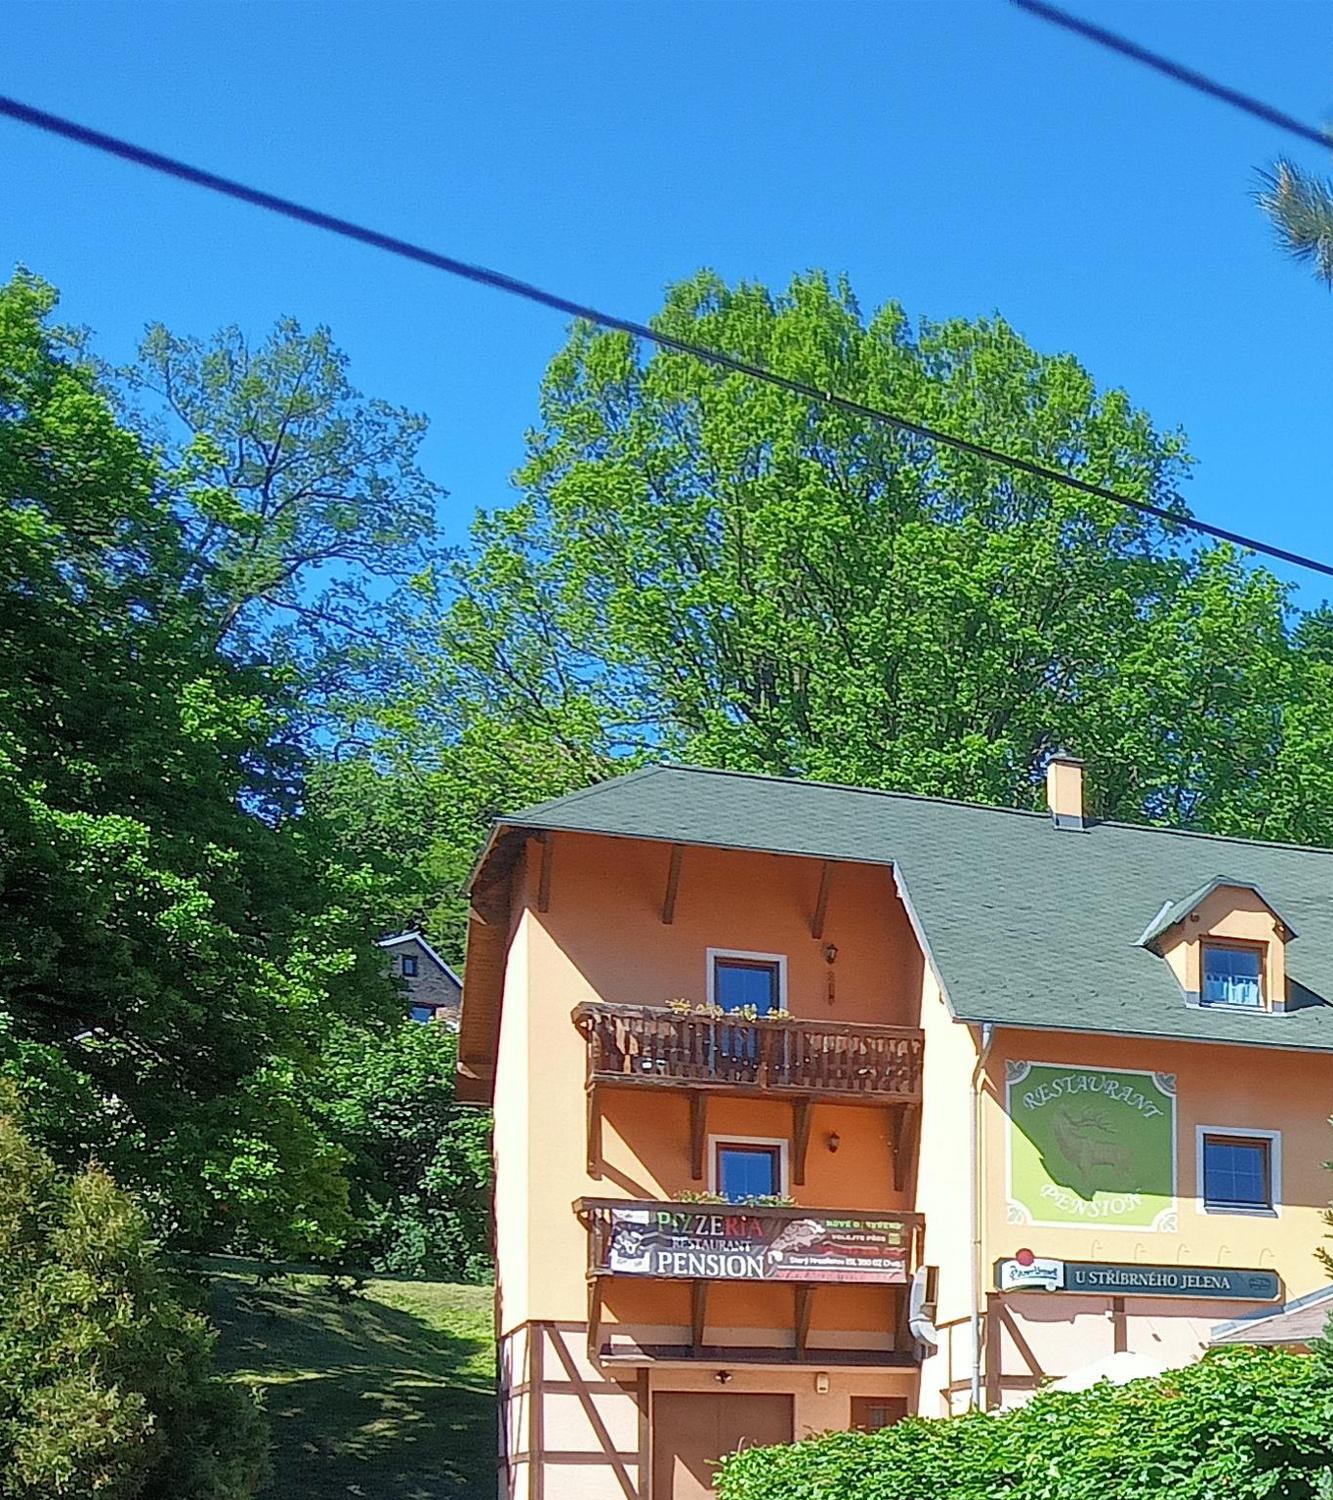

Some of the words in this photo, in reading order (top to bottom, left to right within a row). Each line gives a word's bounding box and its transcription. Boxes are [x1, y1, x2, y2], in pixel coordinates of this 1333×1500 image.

[1023, 1073, 1165, 1119] RESTAURANT
[1040, 1184, 1144, 1219] PENSION
[672, 1236, 752, 1253] RESTAURANT
[657, 1251, 765, 1278] PENSION
[1075, 1270, 1087, 1284] U
[1088, 1268, 1178, 1287] STŘÍBRNÉHO
[1180, 1274, 1231, 1290] JELENA
